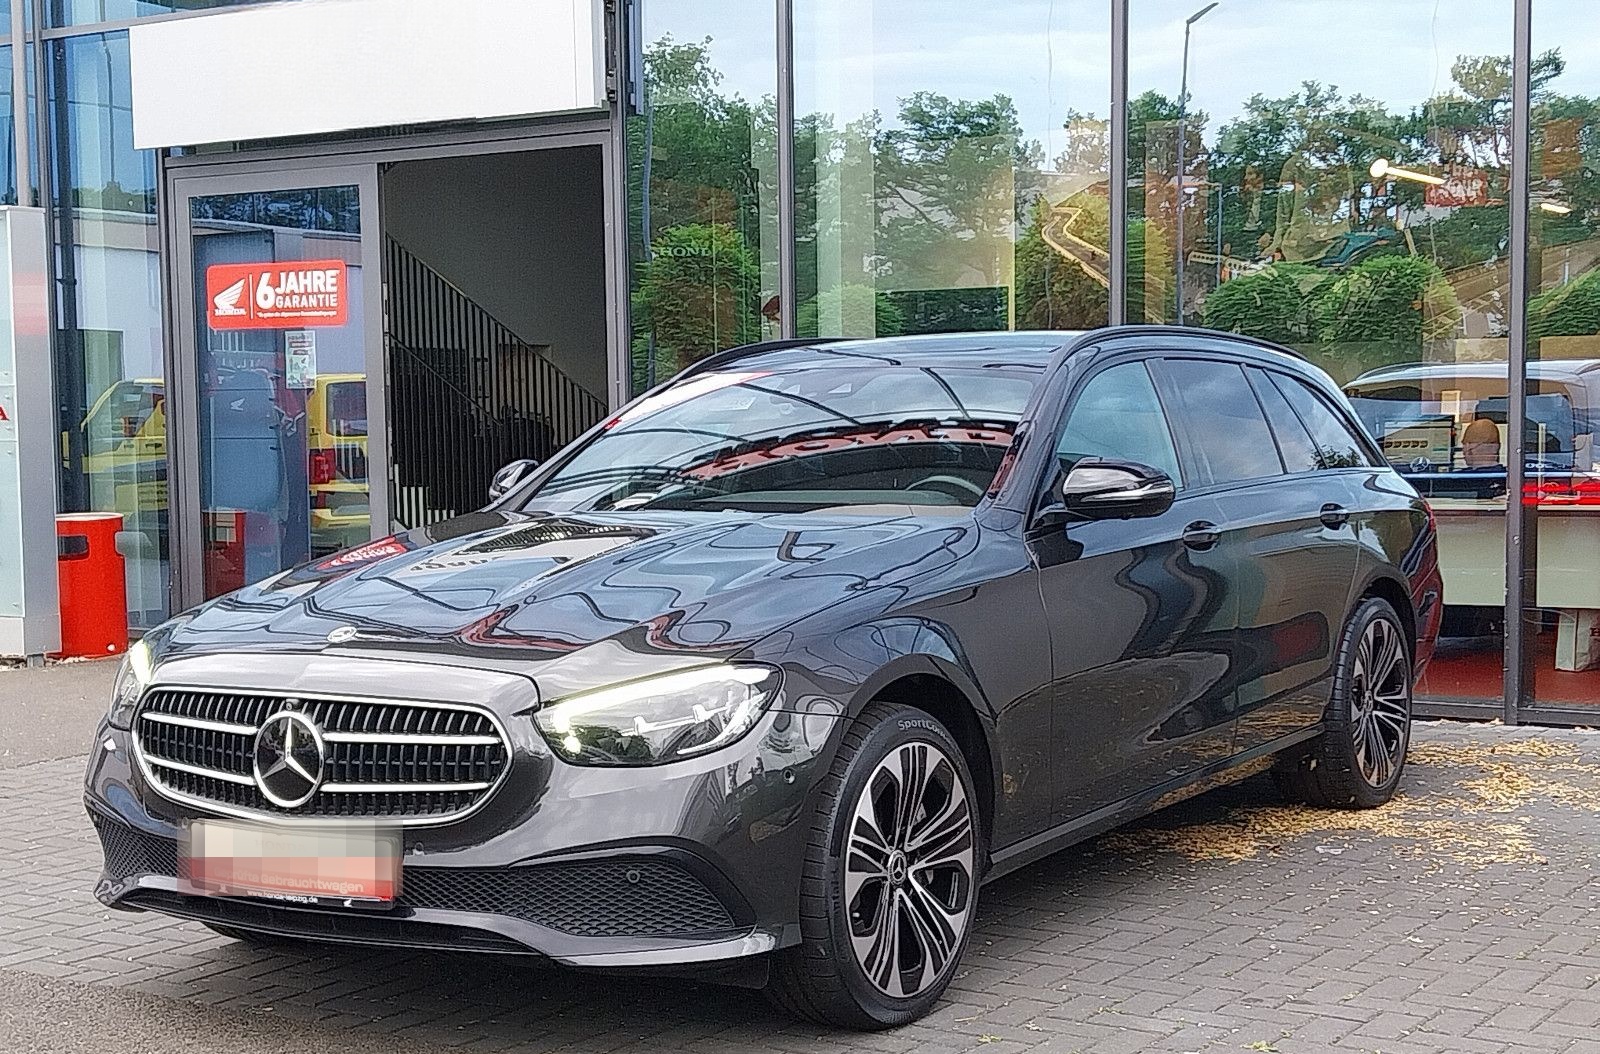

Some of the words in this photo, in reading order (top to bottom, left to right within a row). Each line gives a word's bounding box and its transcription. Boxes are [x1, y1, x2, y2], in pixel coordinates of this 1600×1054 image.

[658, 246, 713, 257] HOND
[255, 272, 276, 309] 6
[275, 269, 340, 294] JAHRE
[275, 294, 338, 308] GARANTIE
[261, 873, 365, 894] Gebrauchtwagen
